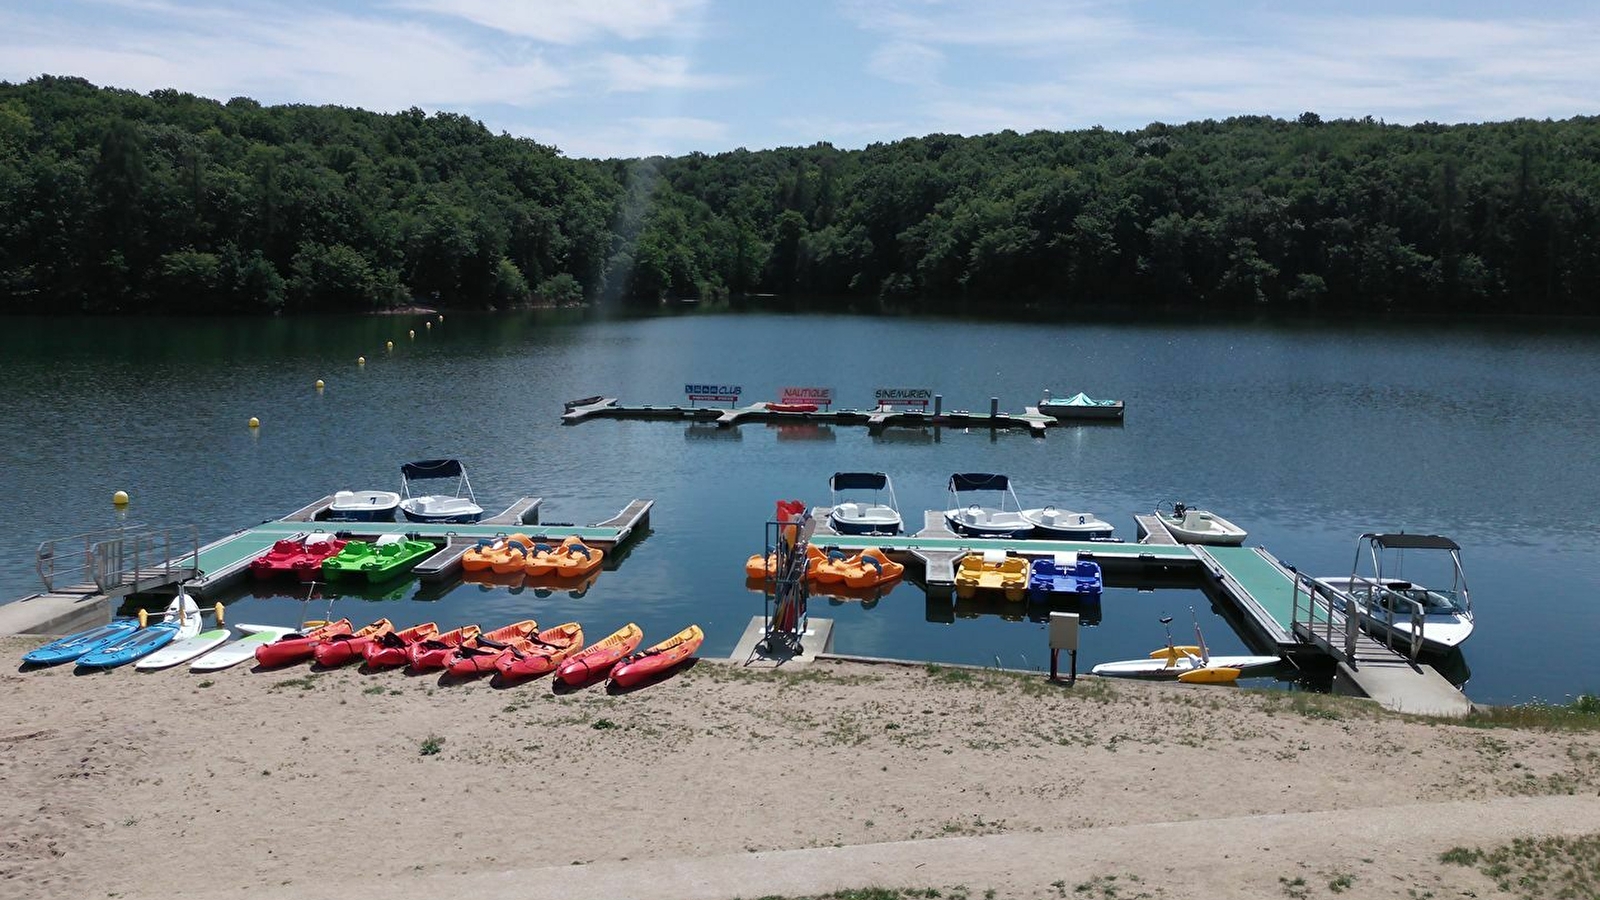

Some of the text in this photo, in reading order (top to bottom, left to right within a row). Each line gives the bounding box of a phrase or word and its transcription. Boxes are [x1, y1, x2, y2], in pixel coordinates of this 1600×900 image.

[718, 386, 742, 395] CLUB
[784, 388, 830, 398] NAUTIQUE
[875, 389, 932, 399] SINEMURIEN
[1078, 516, 1086, 525] 8
